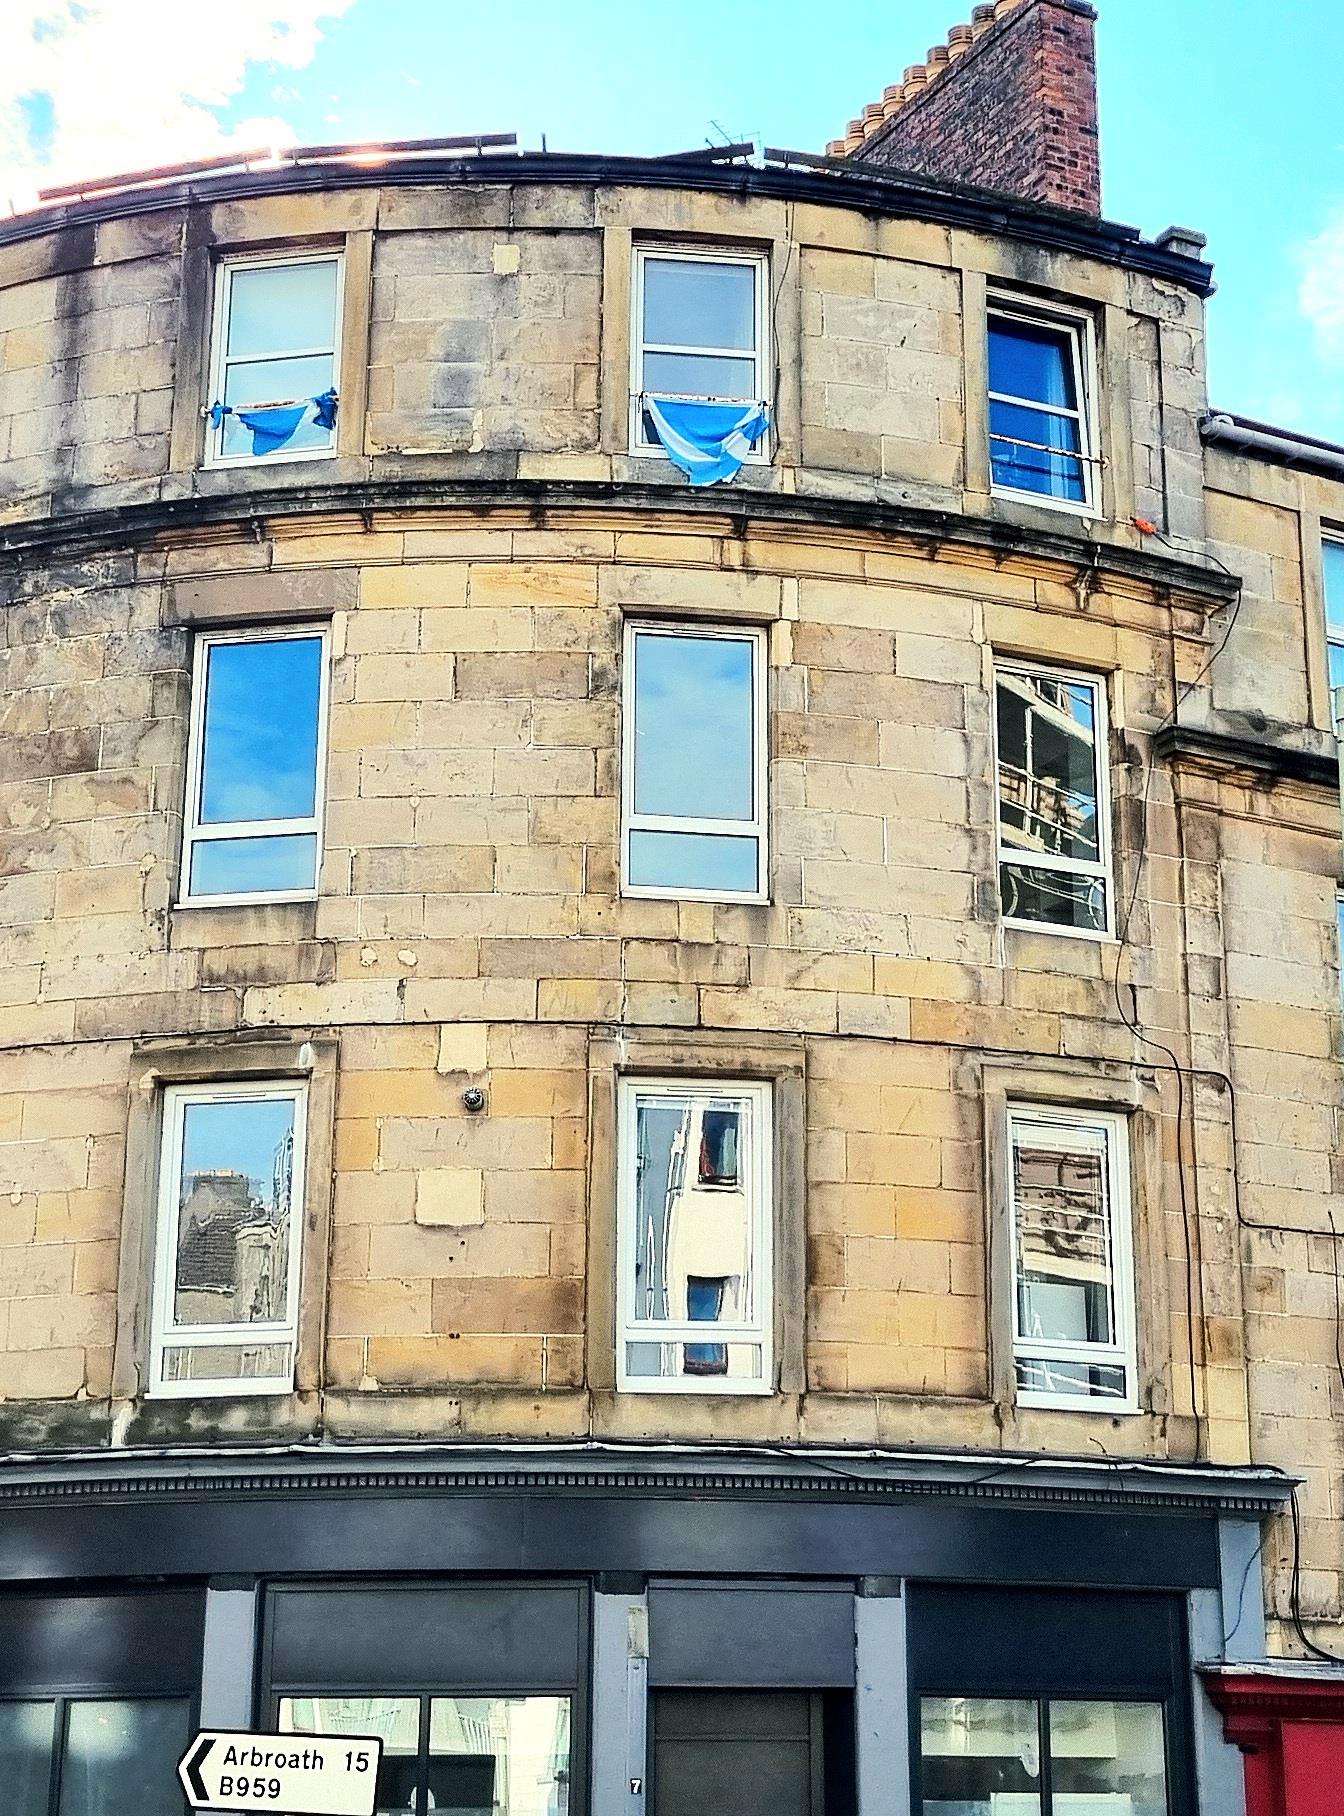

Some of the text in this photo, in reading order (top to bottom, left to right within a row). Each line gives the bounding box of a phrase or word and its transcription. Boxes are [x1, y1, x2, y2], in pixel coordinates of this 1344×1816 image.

[223, 1745, 370, 1773] Arbroath 15
[219, 1775, 281, 1799] B959
[631, 1779, 641, 1794] 7
